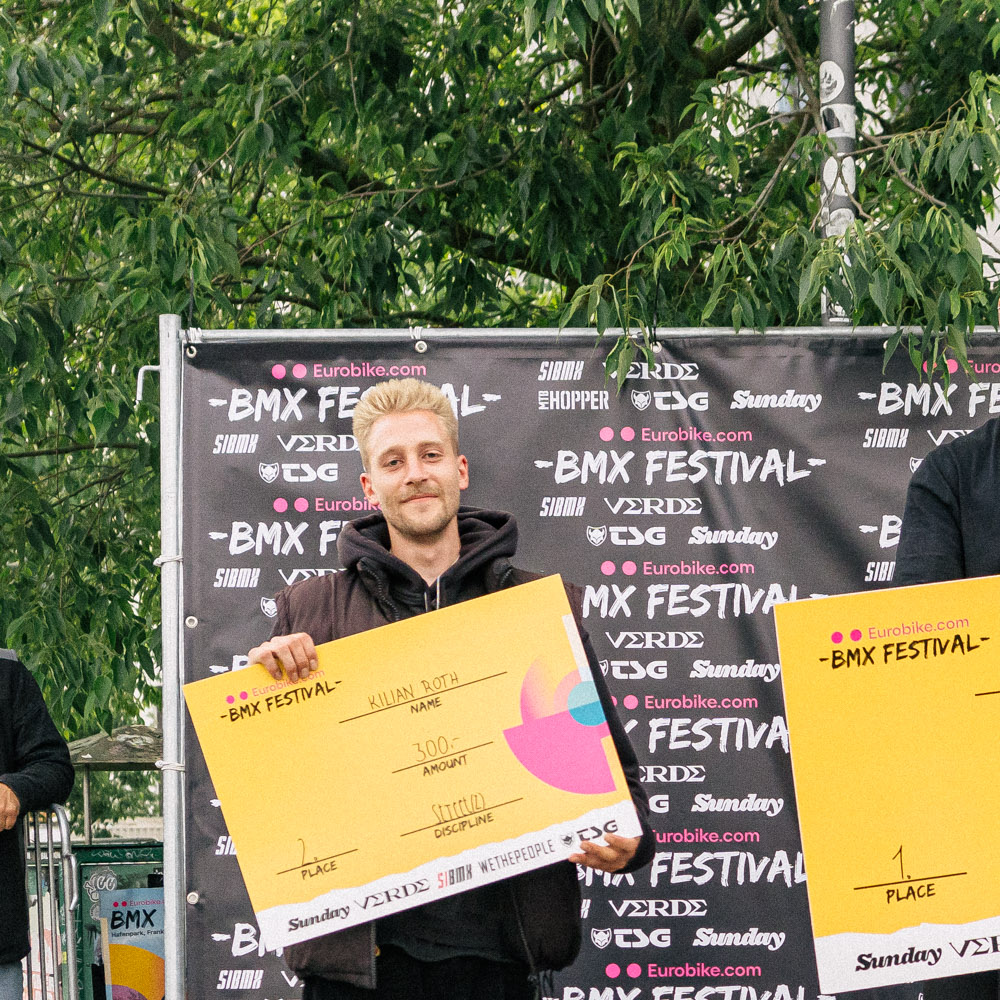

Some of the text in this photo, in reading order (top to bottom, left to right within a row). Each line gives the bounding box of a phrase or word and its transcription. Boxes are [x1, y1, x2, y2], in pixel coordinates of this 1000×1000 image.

[313, 363, 427, 378] Eurobike.com
[538, 389, 823, 412] MTB HOPPER TSG Sunday
[276, 434, 359, 452] VERD
[641, 427, 753, 442] Eurobike.com
[281, 463, 338, 482] TSG
[315, 497, 383, 512] Eurobik
[609, 526, 778, 550] TSG Sunday
[642, 561, 755, 576] Eurobike.com
[868, 617, 970, 640] Eurobike.com
[610, 660, 780, 683] TSG Sunday
[367, 671, 459, 710] KILIAN ROTH
[410, 696, 443, 714] NAME
[644, 695, 758, 709] Eurobike.com
[649, 716, 790, 754] FESTIVA
[422, 754, 468, 777] AMOUNT
[691, 793, 784, 817] Sunday
[434, 813, 494, 838] DISCIPLINE
[653, 829, 760, 843] urobike.com
[301, 861, 338, 880] PLACE
[892, 845, 911, 880] 1.
[288, 904, 350, 933] Sunday
[437, 863, 473, 889] SIBMX
[478, 839, 556, 874] WETHEPEOPLE
[576, 819, 619, 842] TSG
[886, 883, 936, 904] PLACE
[110, 908, 157, 930] BMX
[614, 928, 786, 951] TSG Sunday
[648, 963, 762, 978] Eurobike.com
[855, 947, 942, 972] Sunday
